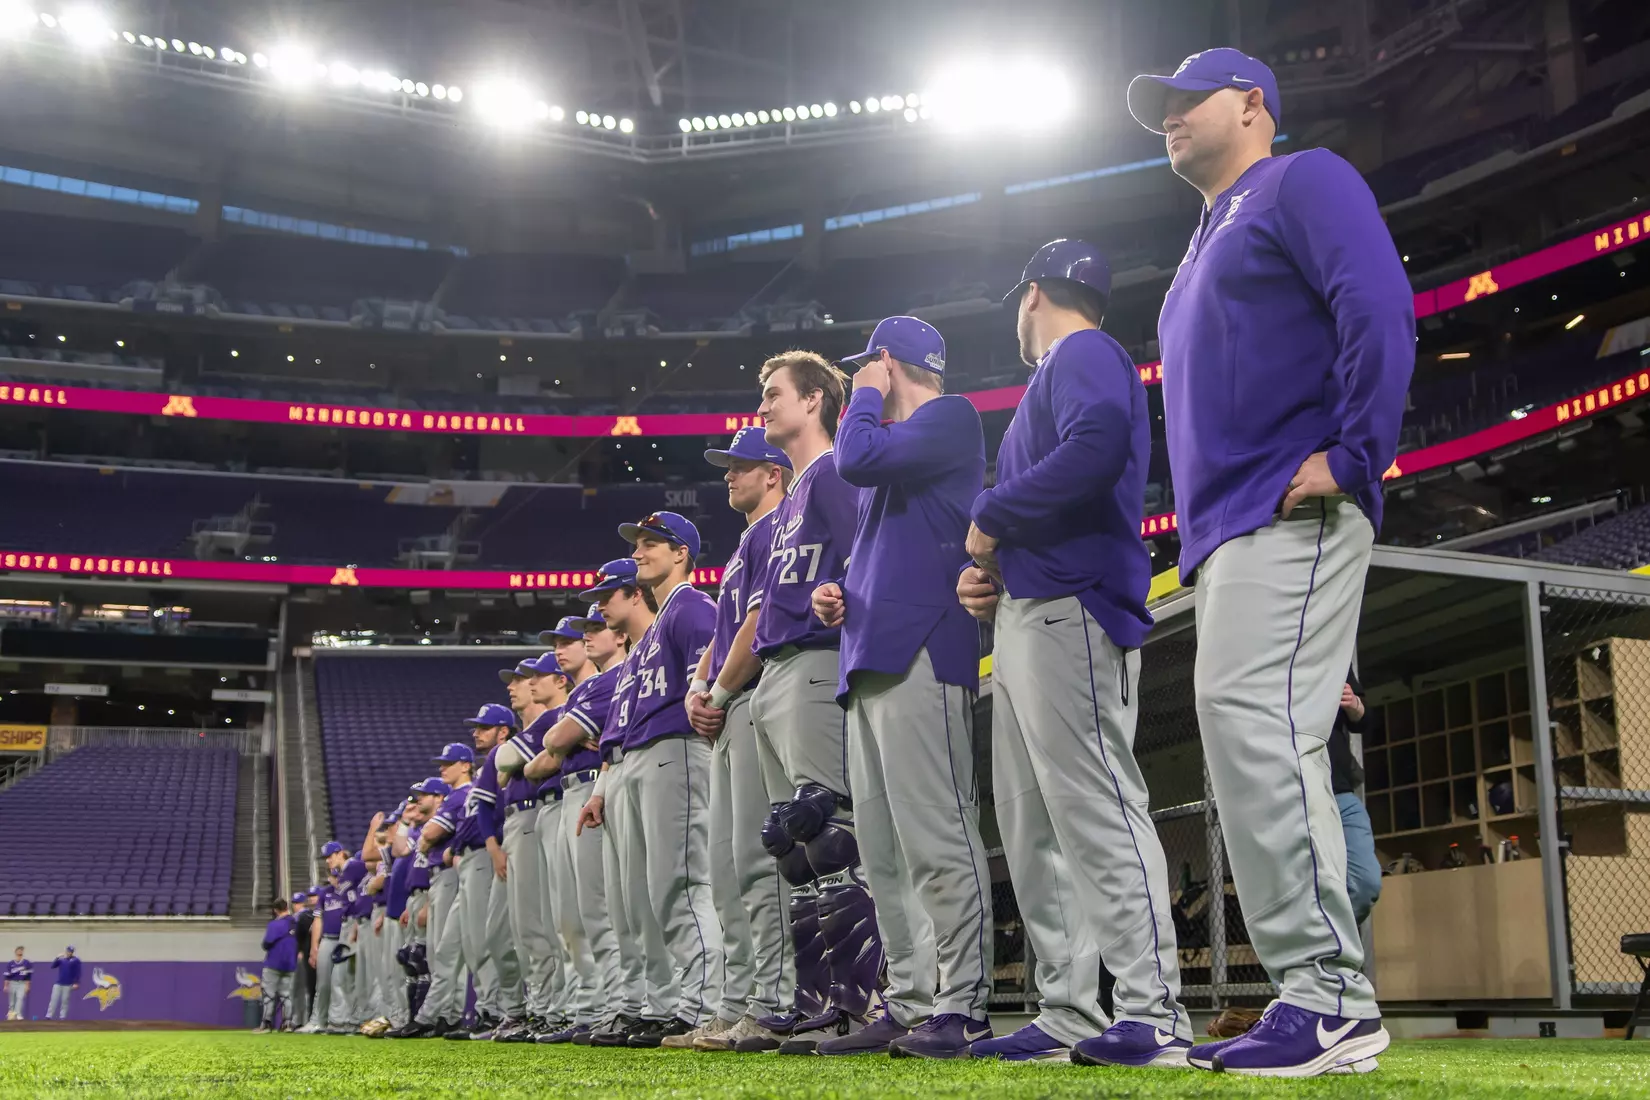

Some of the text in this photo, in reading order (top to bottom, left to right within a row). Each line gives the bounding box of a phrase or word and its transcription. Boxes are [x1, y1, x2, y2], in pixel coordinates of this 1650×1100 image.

[1594, 215, 1650, 252] MINN
[1556, 373, 1650, 422] MINNESO
[289, 406, 525, 432] MINNESOTA BASEBALL
[665, 490, 699, 507] SKOL
[0, 554, 58, 570] SOTA
[70, 557, 172, 575] BASEBALL
[779, 543, 823, 585] 27
[510, 573, 594, 588] MINNESO
[638, 665, 667, 699] 34
[618, 700, 630, 727] 9
[0, 730, 43, 745] SHIPS
